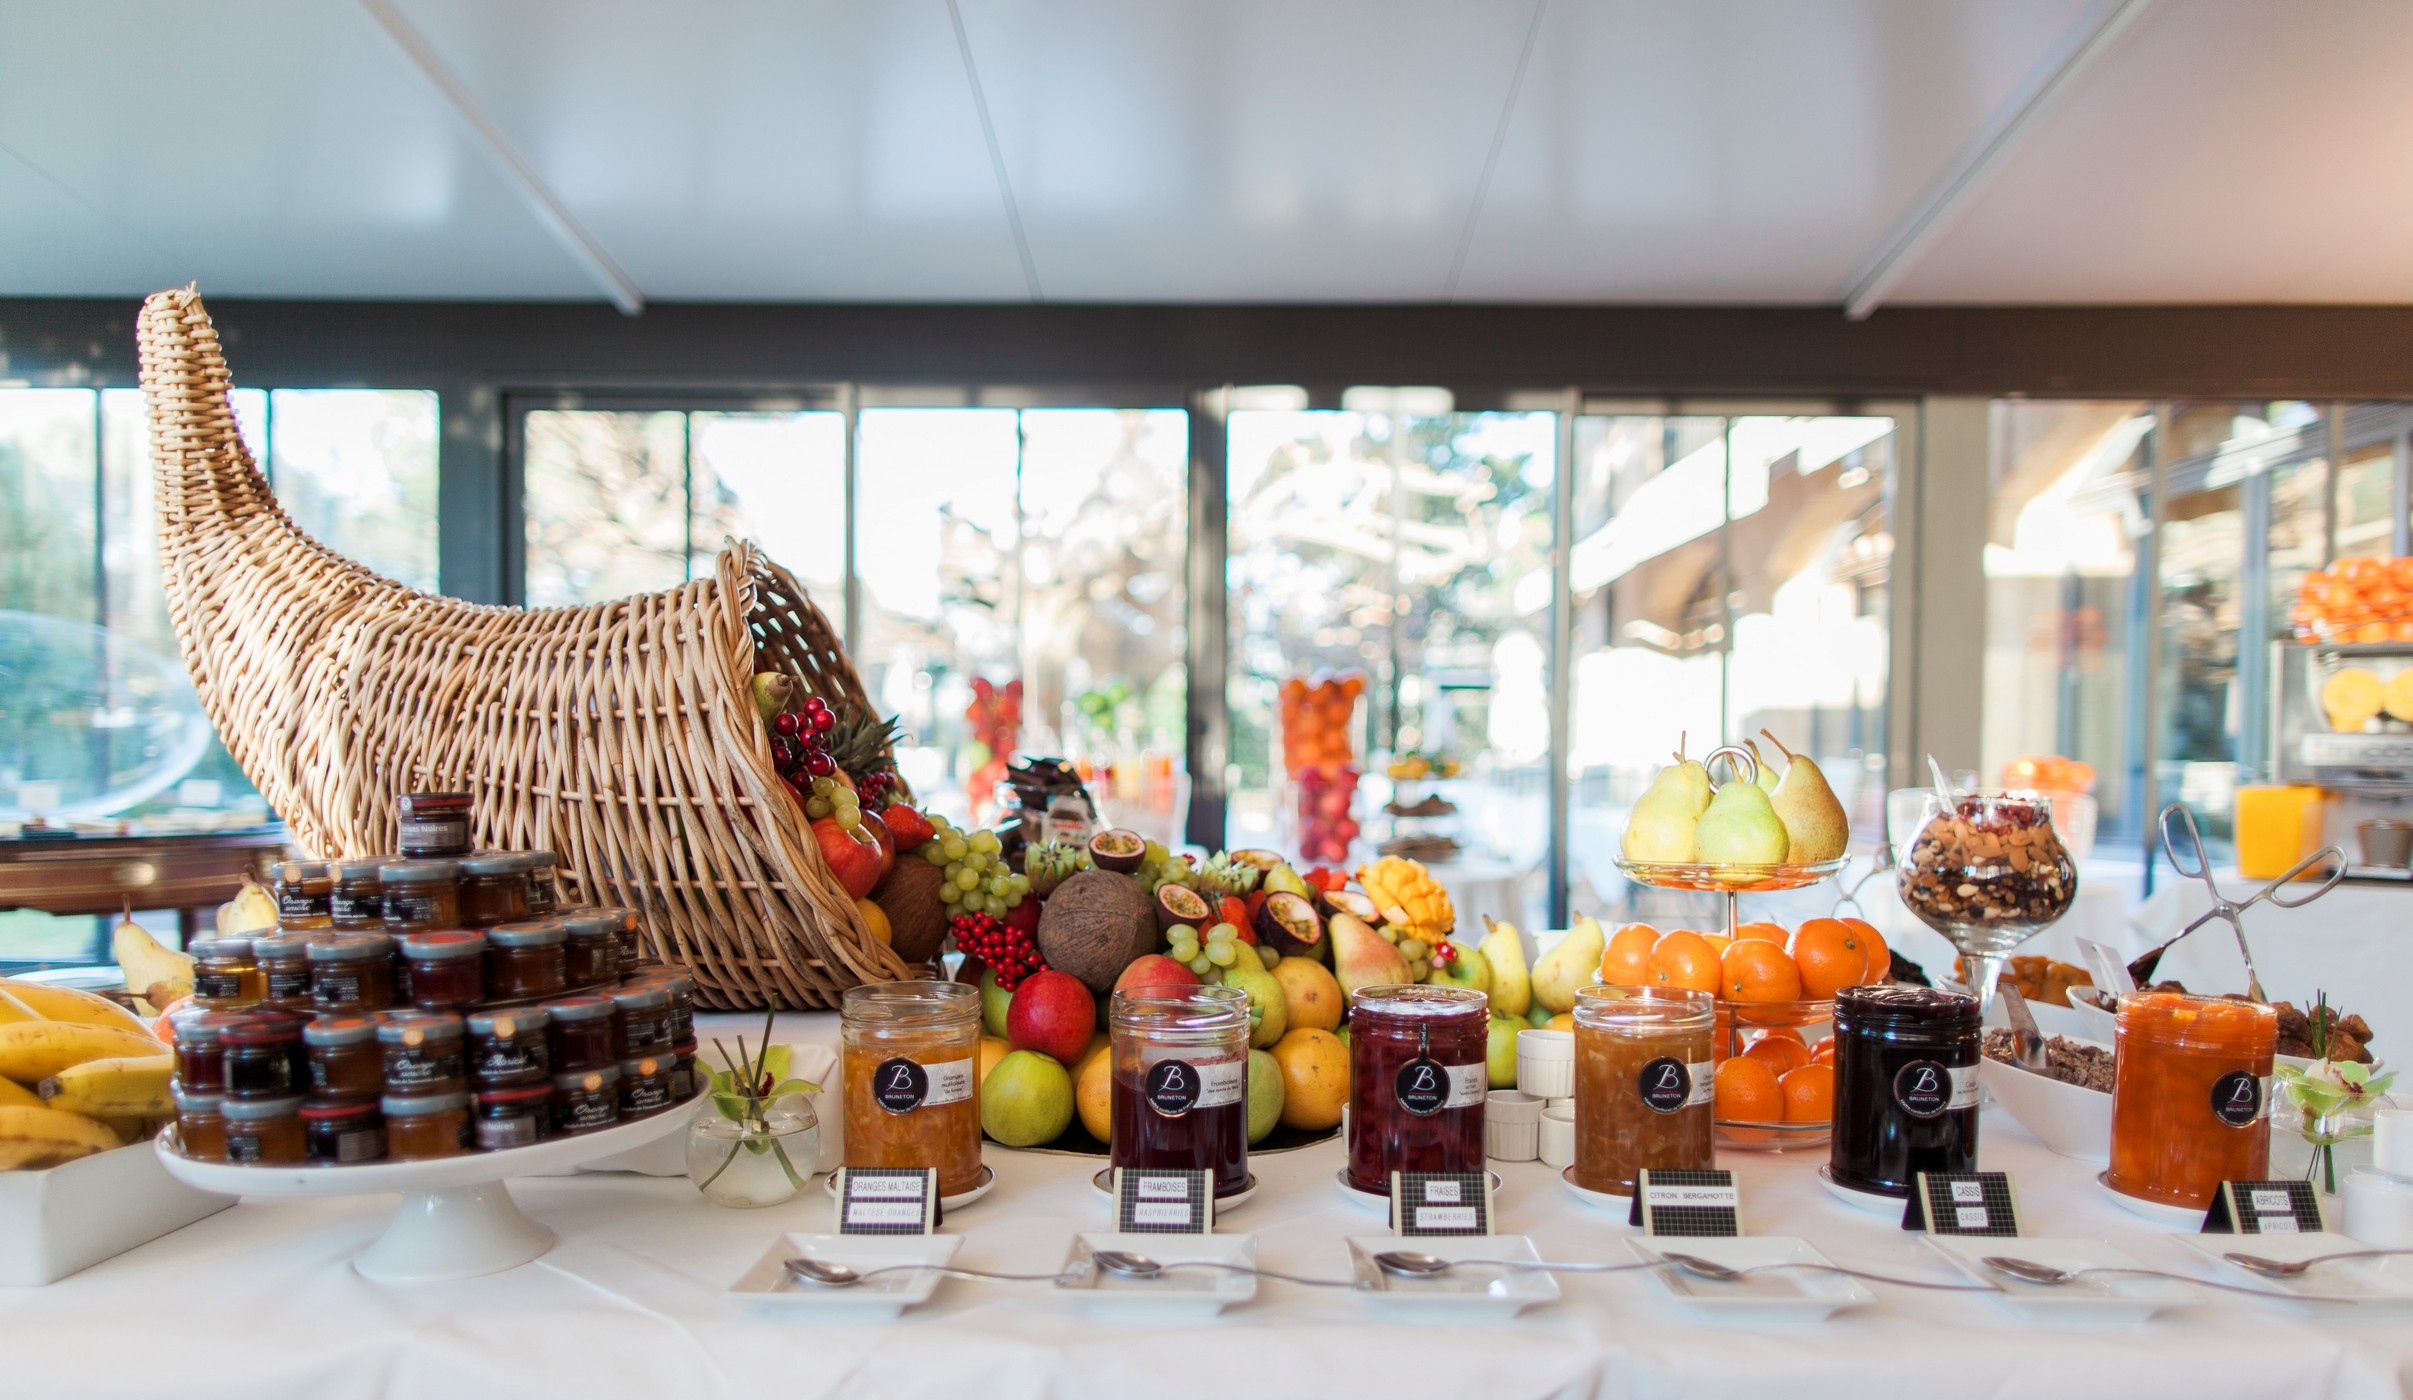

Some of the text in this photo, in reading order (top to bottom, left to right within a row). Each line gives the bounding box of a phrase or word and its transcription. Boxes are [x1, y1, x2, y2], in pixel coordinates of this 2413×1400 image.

[421, 825, 448, 833] Noires
[885, 1064, 912, 1091] B
[1158, 1065, 1184, 1092] B
[1409, 1065, 1435, 1091] B
[1653, 1064, 1679, 1090] B
[1910, 1067, 1937, 1092] B
[2227, 1077, 2252, 1103] B
[853, 1181, 921, 1192] ORANGES MALTAISE
[1143, 1181, 1186, 1192] FRAMBOISES
[1430, 1185, 1459, 1197] FRAISES
[1956, 1186, 1980, 1197] CASSIS
[1683, 1192, 1734, 1200] BERGAMOTTE
[2255, 1195, 2289, 1206] ABRICOTS
[853, 1208, 920, 1217] MALTESE ORANGES
[1420, 1212, 1473, 1221] STRAWBERRIES
[1960, 1212, 1985, 1222] CASSIS
[2264, 1222, 2297, 1231] APRICOTS
